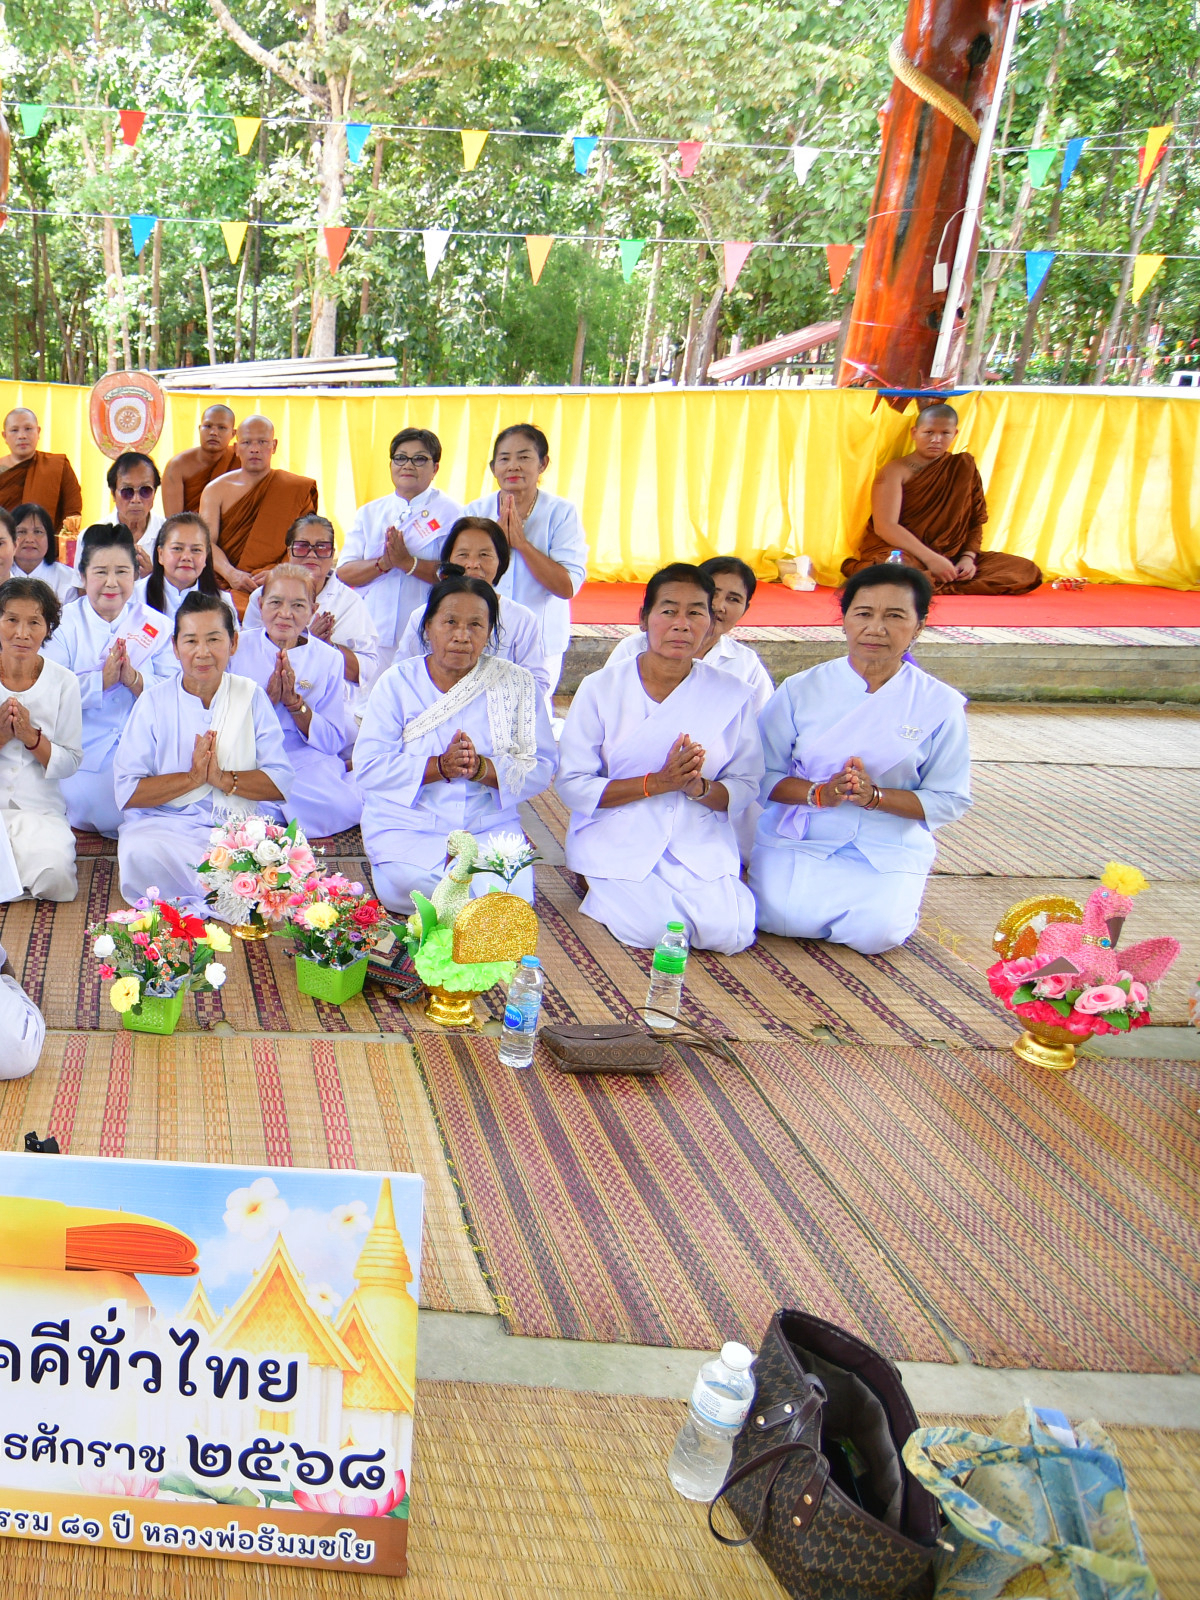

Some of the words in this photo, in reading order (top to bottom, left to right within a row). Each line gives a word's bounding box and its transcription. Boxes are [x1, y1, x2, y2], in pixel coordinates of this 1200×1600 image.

[186, 1434, 386, 1490] ๒๕๖๘
[61, 1517, 100, 1538] ๘๑
[112, 1513, 131, 1539] ปี
[143, 1524, 371, 1560] หลวงพ่อธัมมชโย
